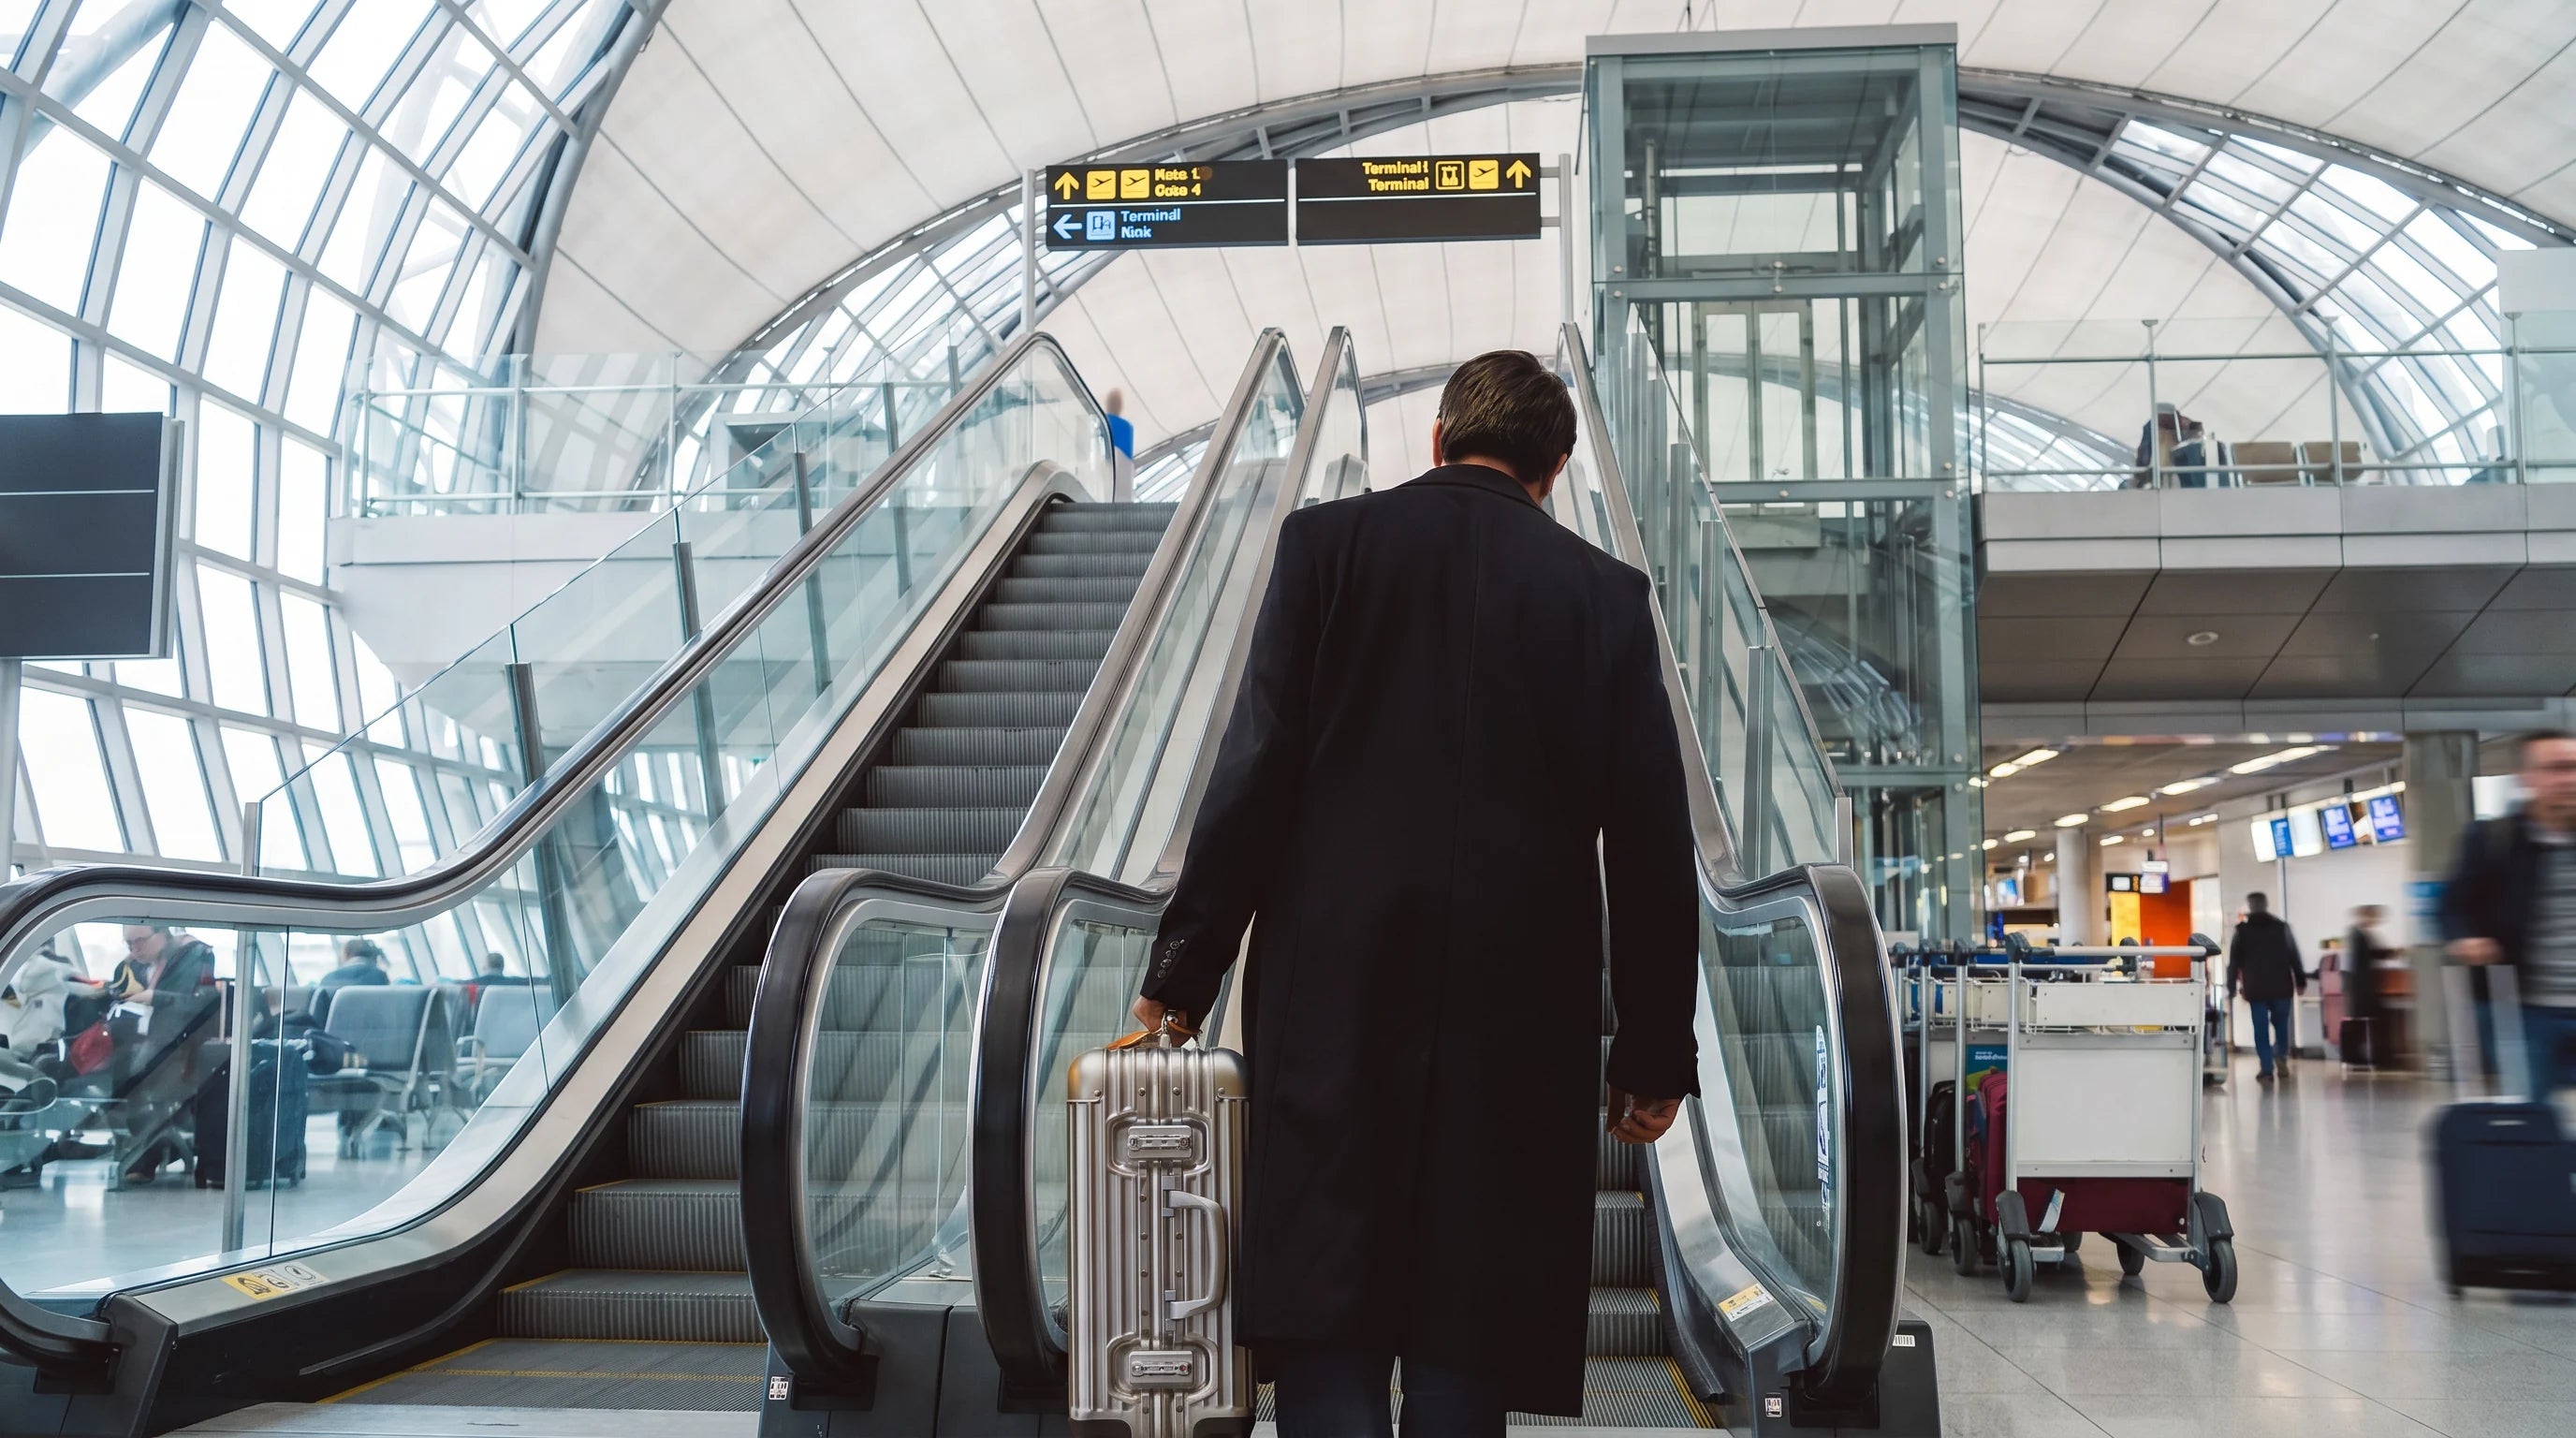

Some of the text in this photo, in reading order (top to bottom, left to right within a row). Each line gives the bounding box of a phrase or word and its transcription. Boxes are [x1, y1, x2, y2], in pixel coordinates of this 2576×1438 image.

[1191, 183, 1202, 196] 4
[1368, 176, 1429, 191] Terminal
[1120, 207, 1181, 223] Terminal
